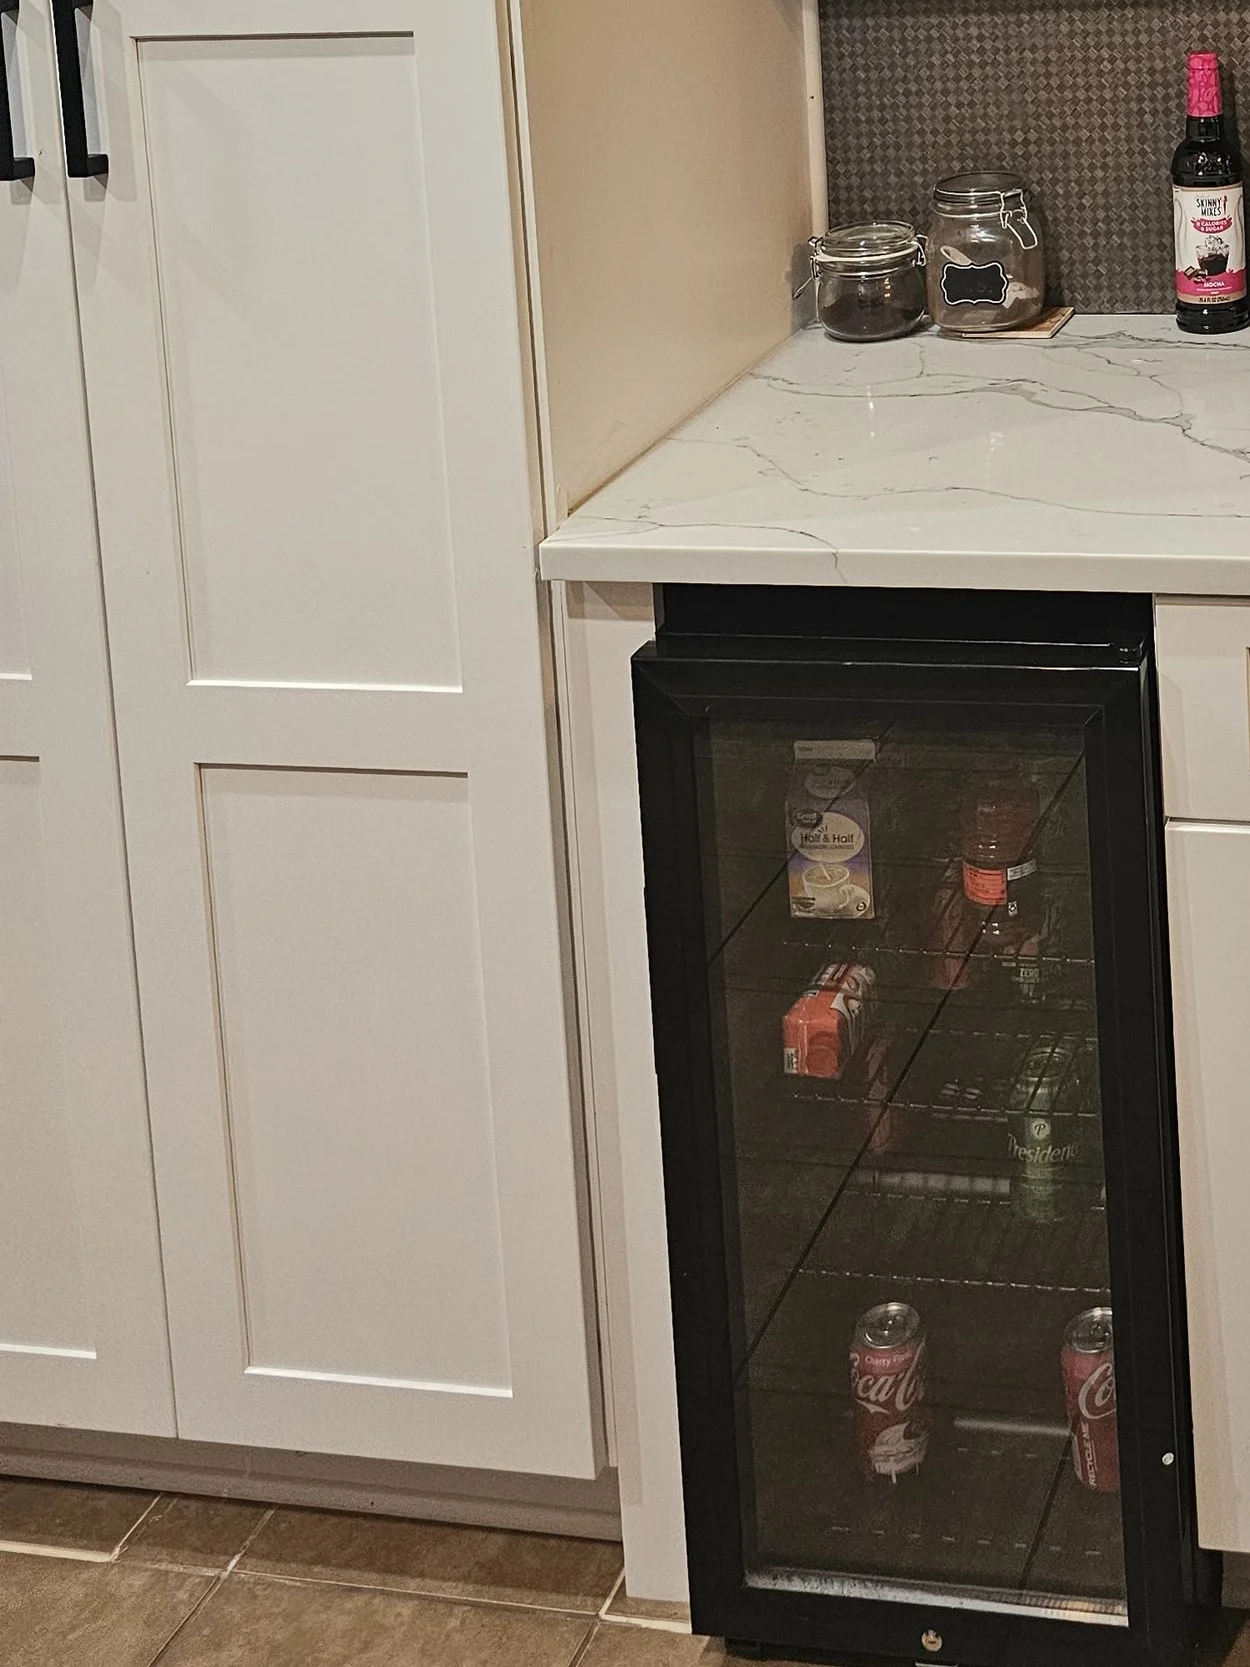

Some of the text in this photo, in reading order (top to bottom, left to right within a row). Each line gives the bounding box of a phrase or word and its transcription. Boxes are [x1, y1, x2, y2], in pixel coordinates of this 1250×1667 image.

[1196, 197, 1222, 208] SKINNY
[1201, 207, 1221, 217] MIXES
[1201, 219, 1228, 227] CALORIES
[800, 833, 854, 843] Half & Half
[1084, 1440, 1097, 1487] RECYCLE
